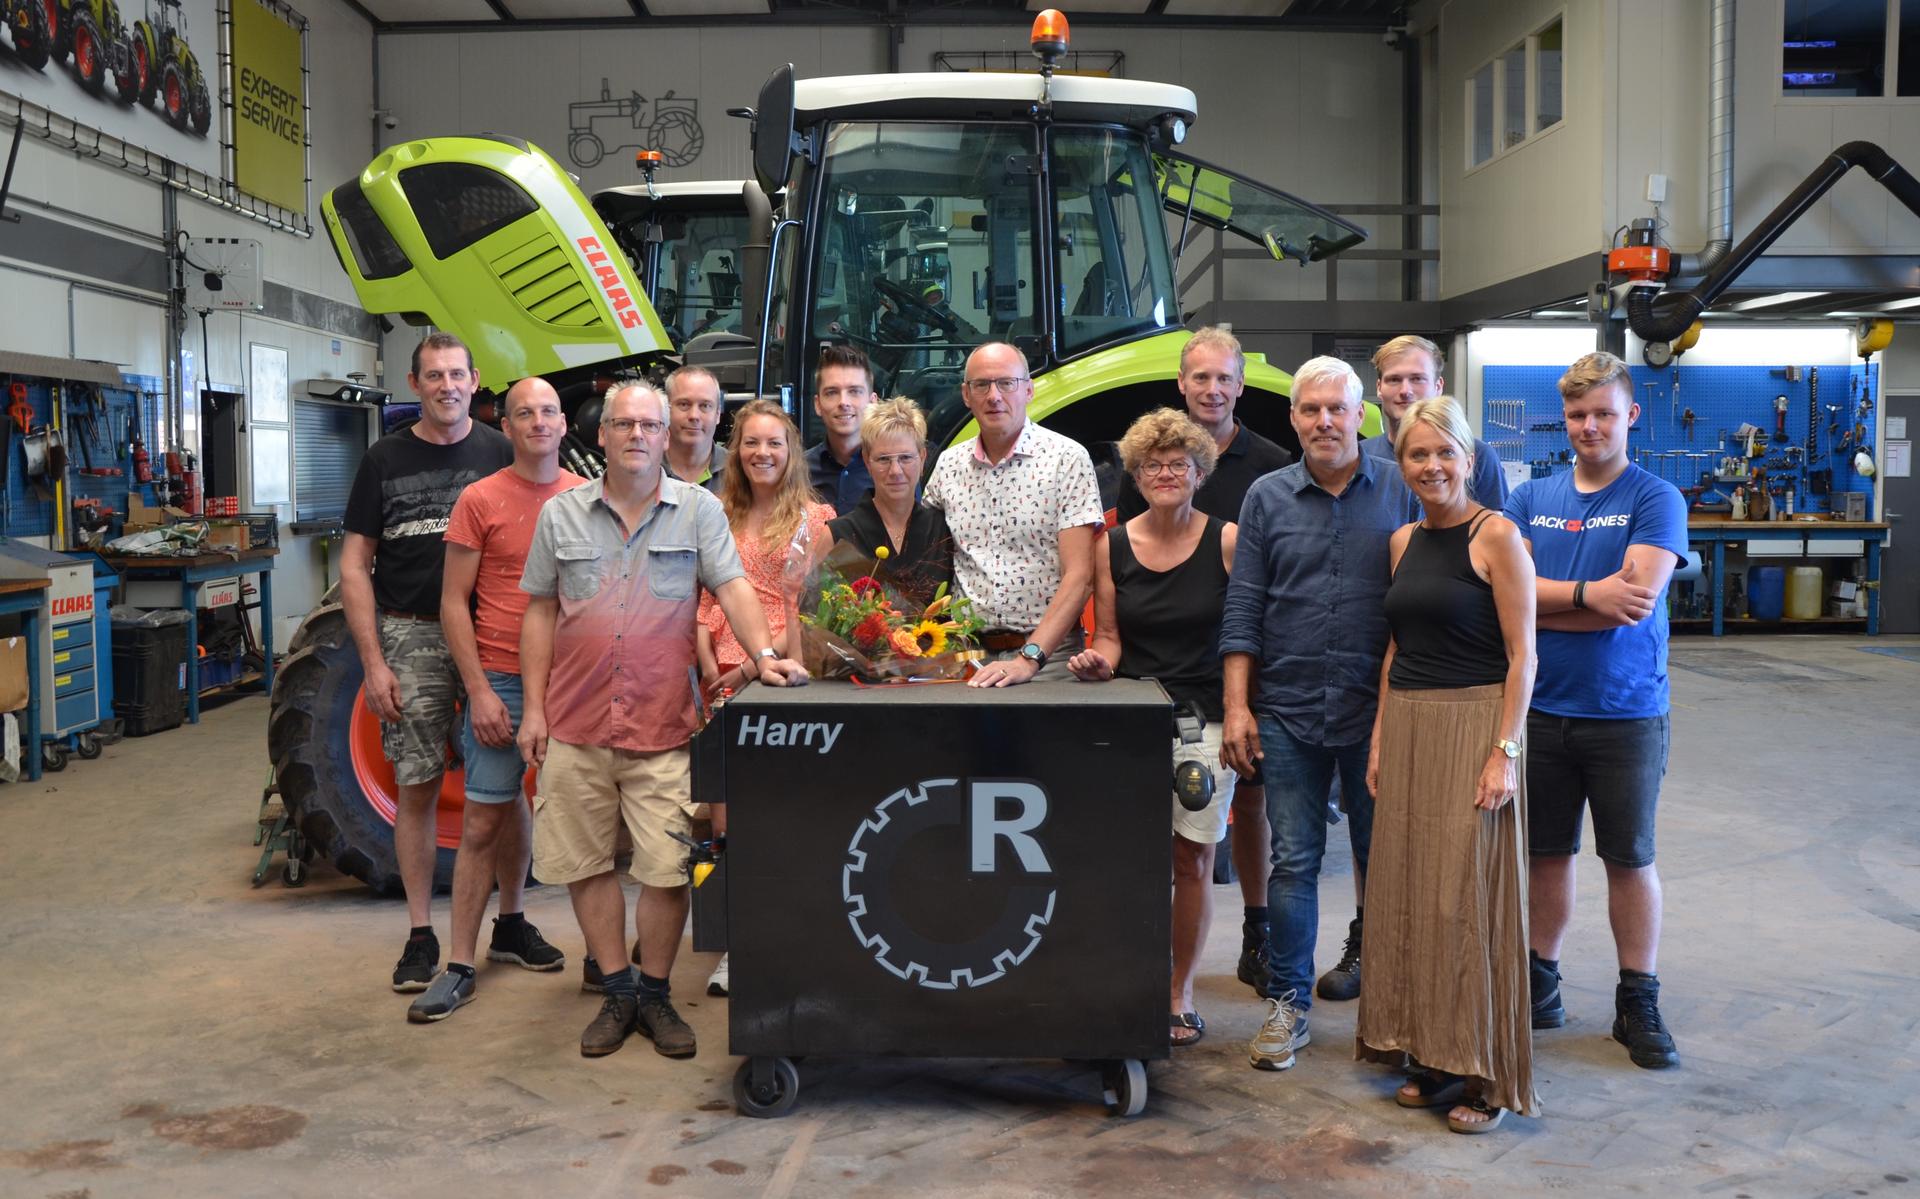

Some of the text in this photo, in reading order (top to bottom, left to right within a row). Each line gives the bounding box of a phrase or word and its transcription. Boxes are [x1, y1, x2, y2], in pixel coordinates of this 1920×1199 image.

[241, 67, 298, 116] EXPERT
[241, 95, 300, 145] SERVICE
[576, 236, 643, 329] CLAAS
[1529, 515, 1567, 530] JACK
[51, 594, 93, 616] CLAAS
[212, 592, 233, 606] CLAAS
[737, 715, 845, 754] Harry
[971, 782, 1052, 872] R
